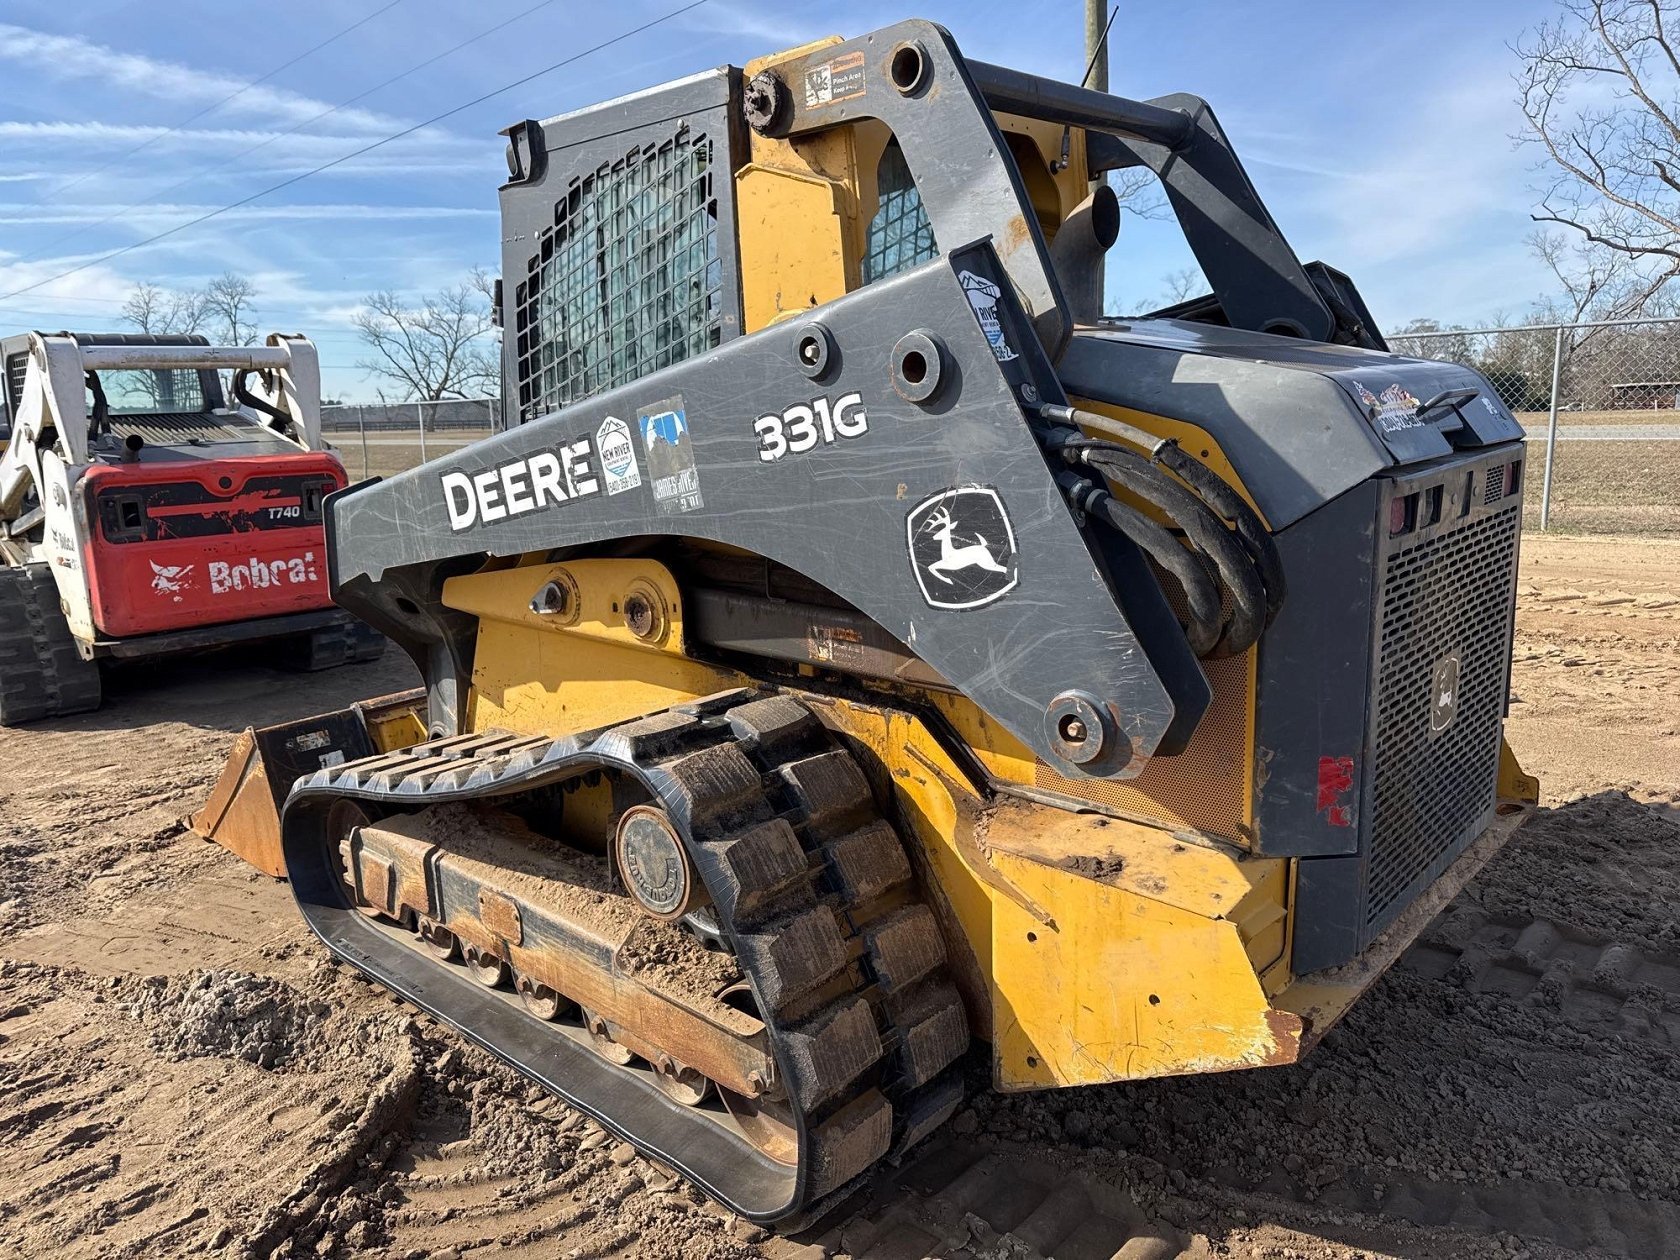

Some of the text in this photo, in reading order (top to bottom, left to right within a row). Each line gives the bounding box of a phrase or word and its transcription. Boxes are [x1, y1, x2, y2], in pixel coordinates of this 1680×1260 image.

[849, 72, 862, 81] Area
[754, 393, 868, 461] 331G
[601, 442, 631, 462] NEW RIVER
[441, 439, 599, 531] DEERE
[268, 506, 300, 519] T740
[208, 551, 318, 594] Bobcat
